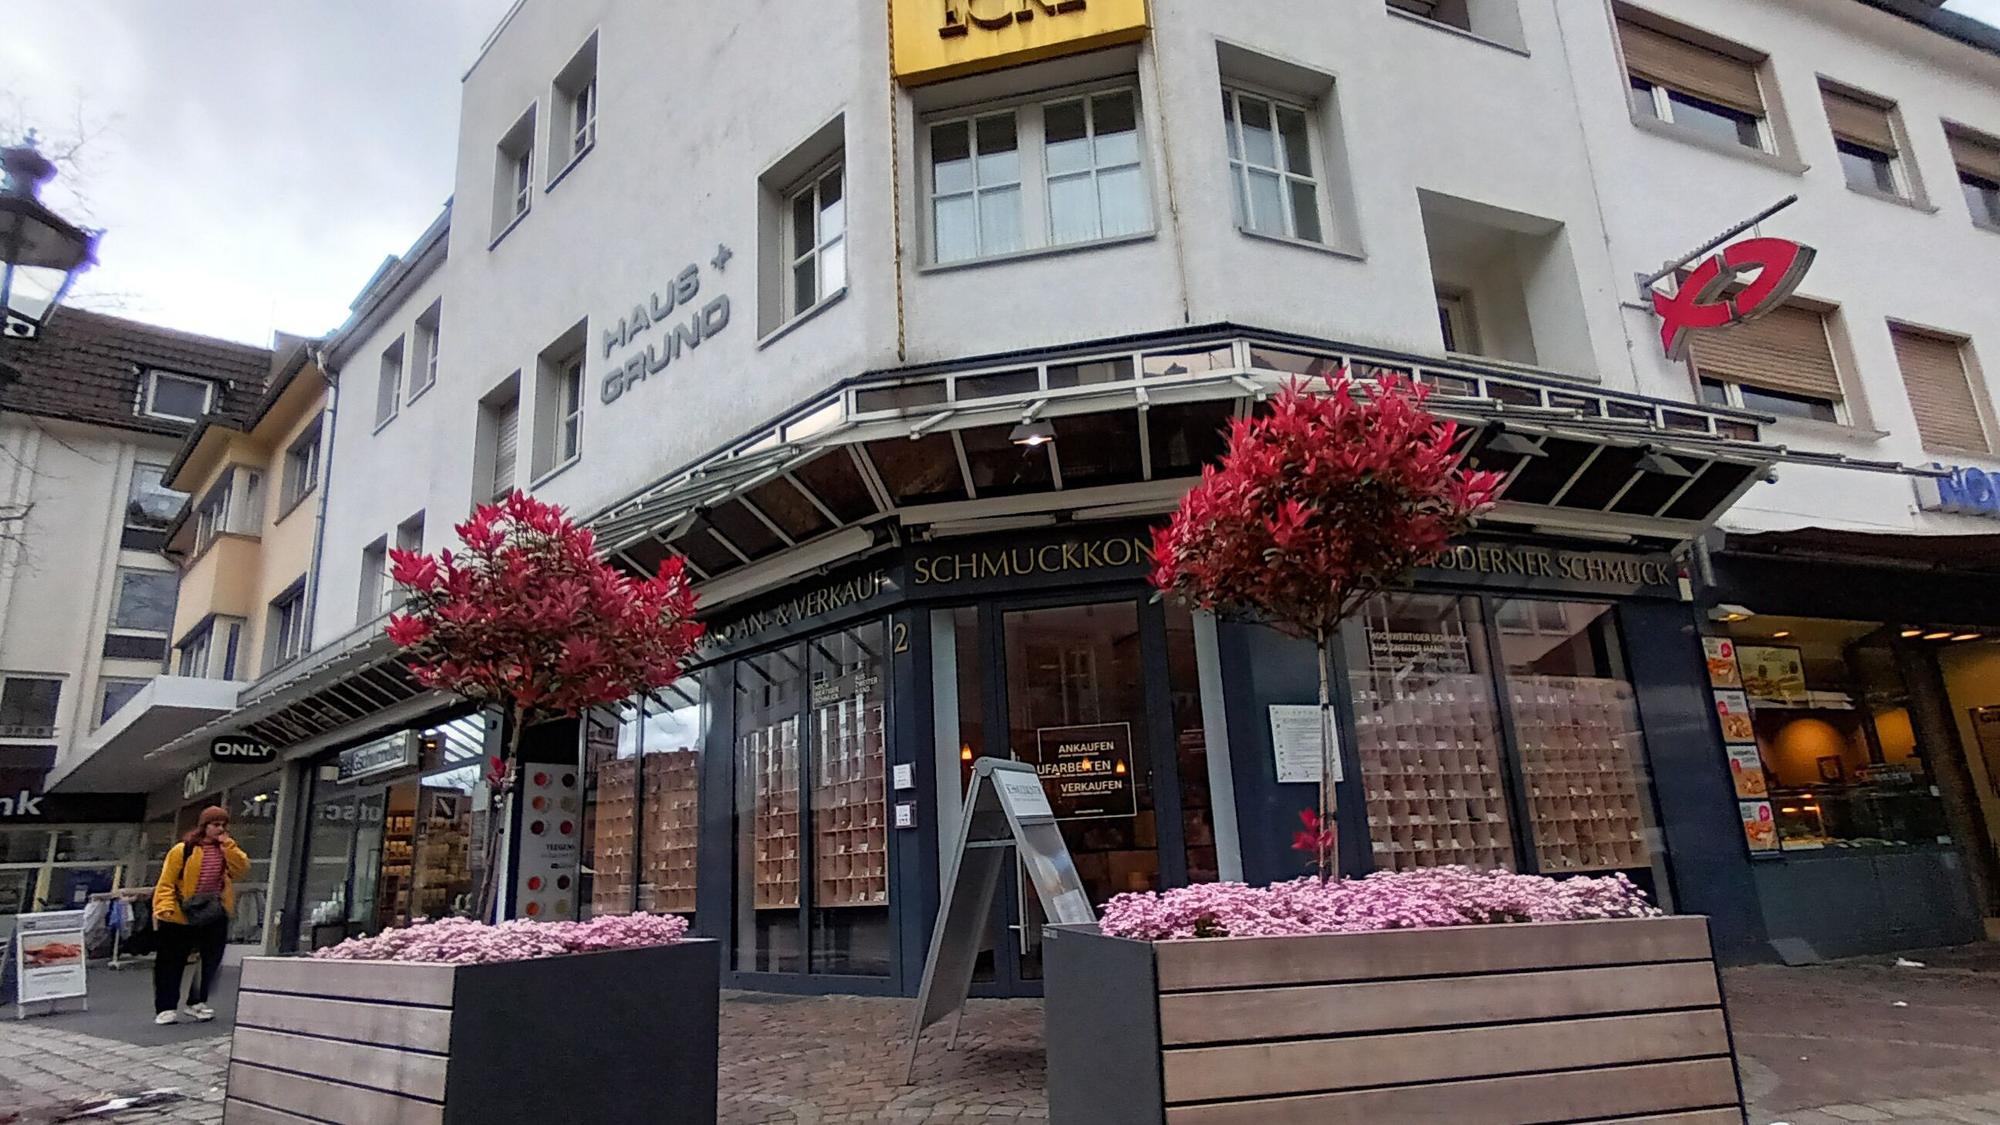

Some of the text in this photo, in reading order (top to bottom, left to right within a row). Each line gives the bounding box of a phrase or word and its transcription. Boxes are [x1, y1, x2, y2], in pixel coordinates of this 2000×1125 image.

[602, 243, 733, 359] HAUS +
[600, 294, 730, 405] GRUND
[1558, 553, 1669, 585] SCHMUCK
[793, 568, 890, 620] VERKAUF
[893, 622, 909, 654] 2
[214, 743, 270, 757] ONLY
[1058, 741, 1115, 754] ANKAUFEN
[184, 761, 212, 799] ONLY
[1060, 780, 1122, 793] VERKAUFEN
